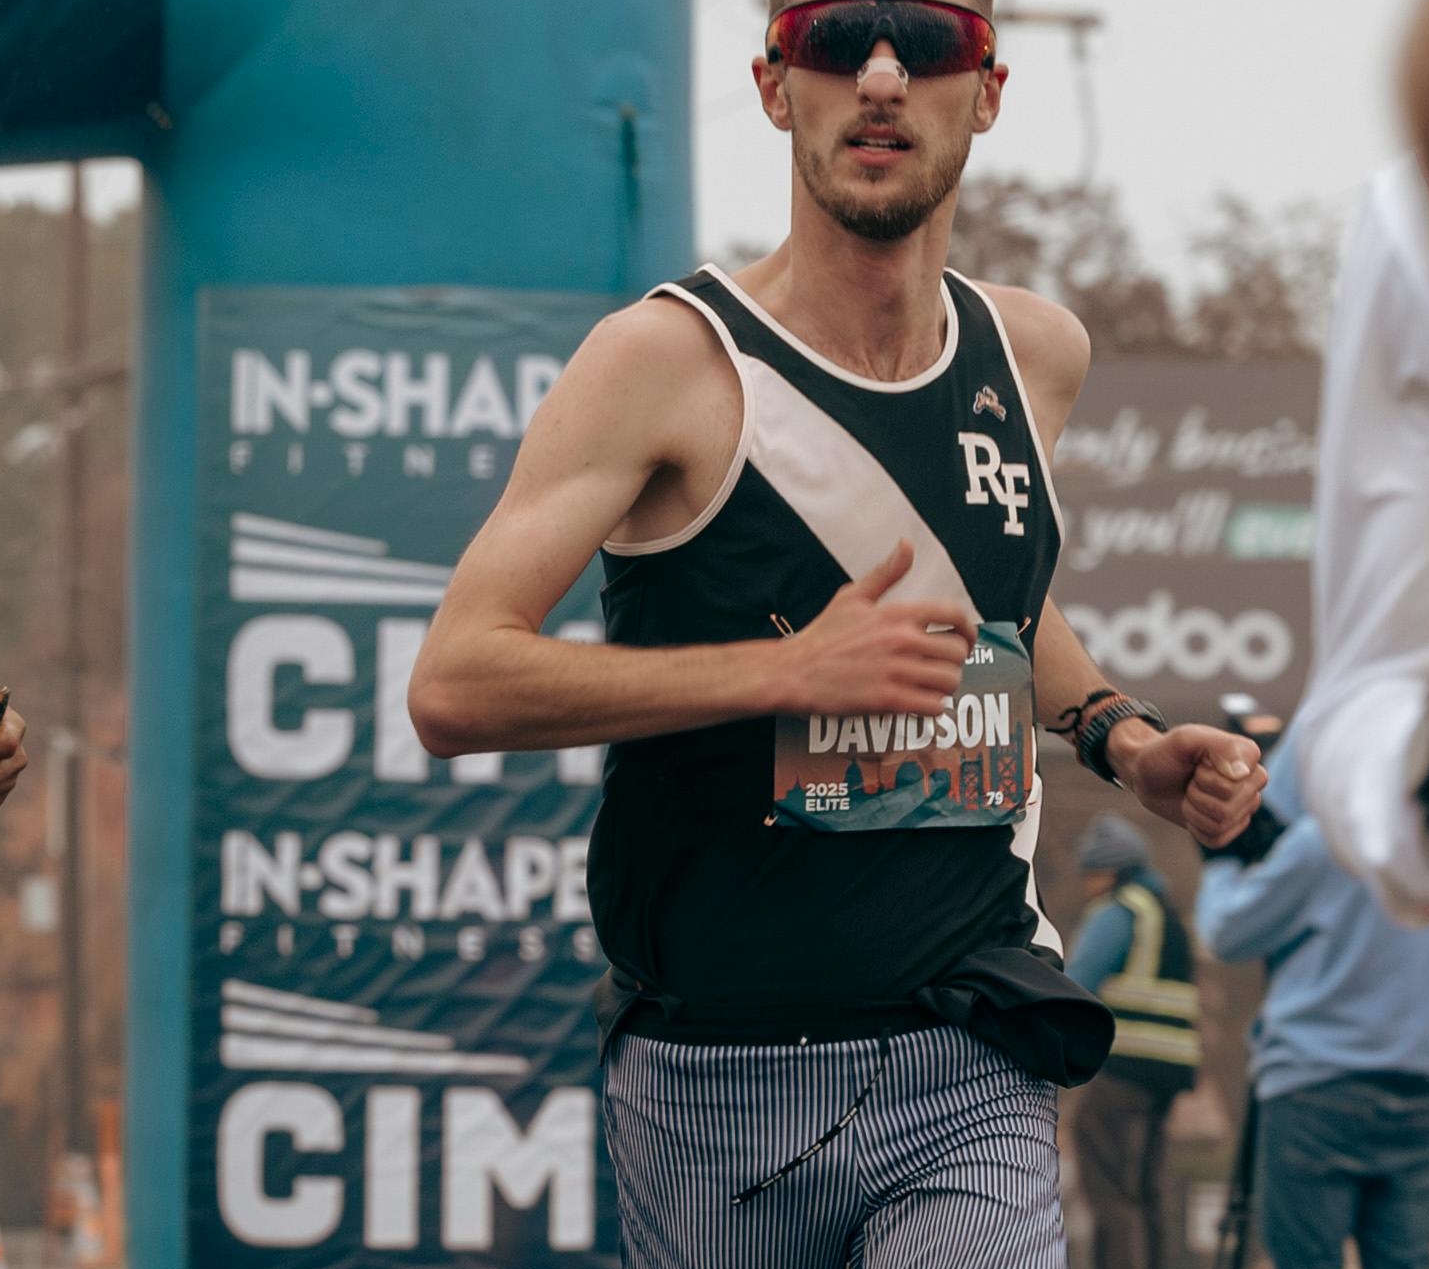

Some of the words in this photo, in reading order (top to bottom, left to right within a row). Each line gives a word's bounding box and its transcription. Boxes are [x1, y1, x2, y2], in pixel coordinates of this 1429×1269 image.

[958, 432, 1030, 536] RF
[808, 692, 1010, 754] DAVIDSON
[805, 783, 848, 797] 2025
[805, 797, 850, 811] ELITE
[986, 791, 1004, 806] 79
[217, 1081, 596, 1251] CIM
